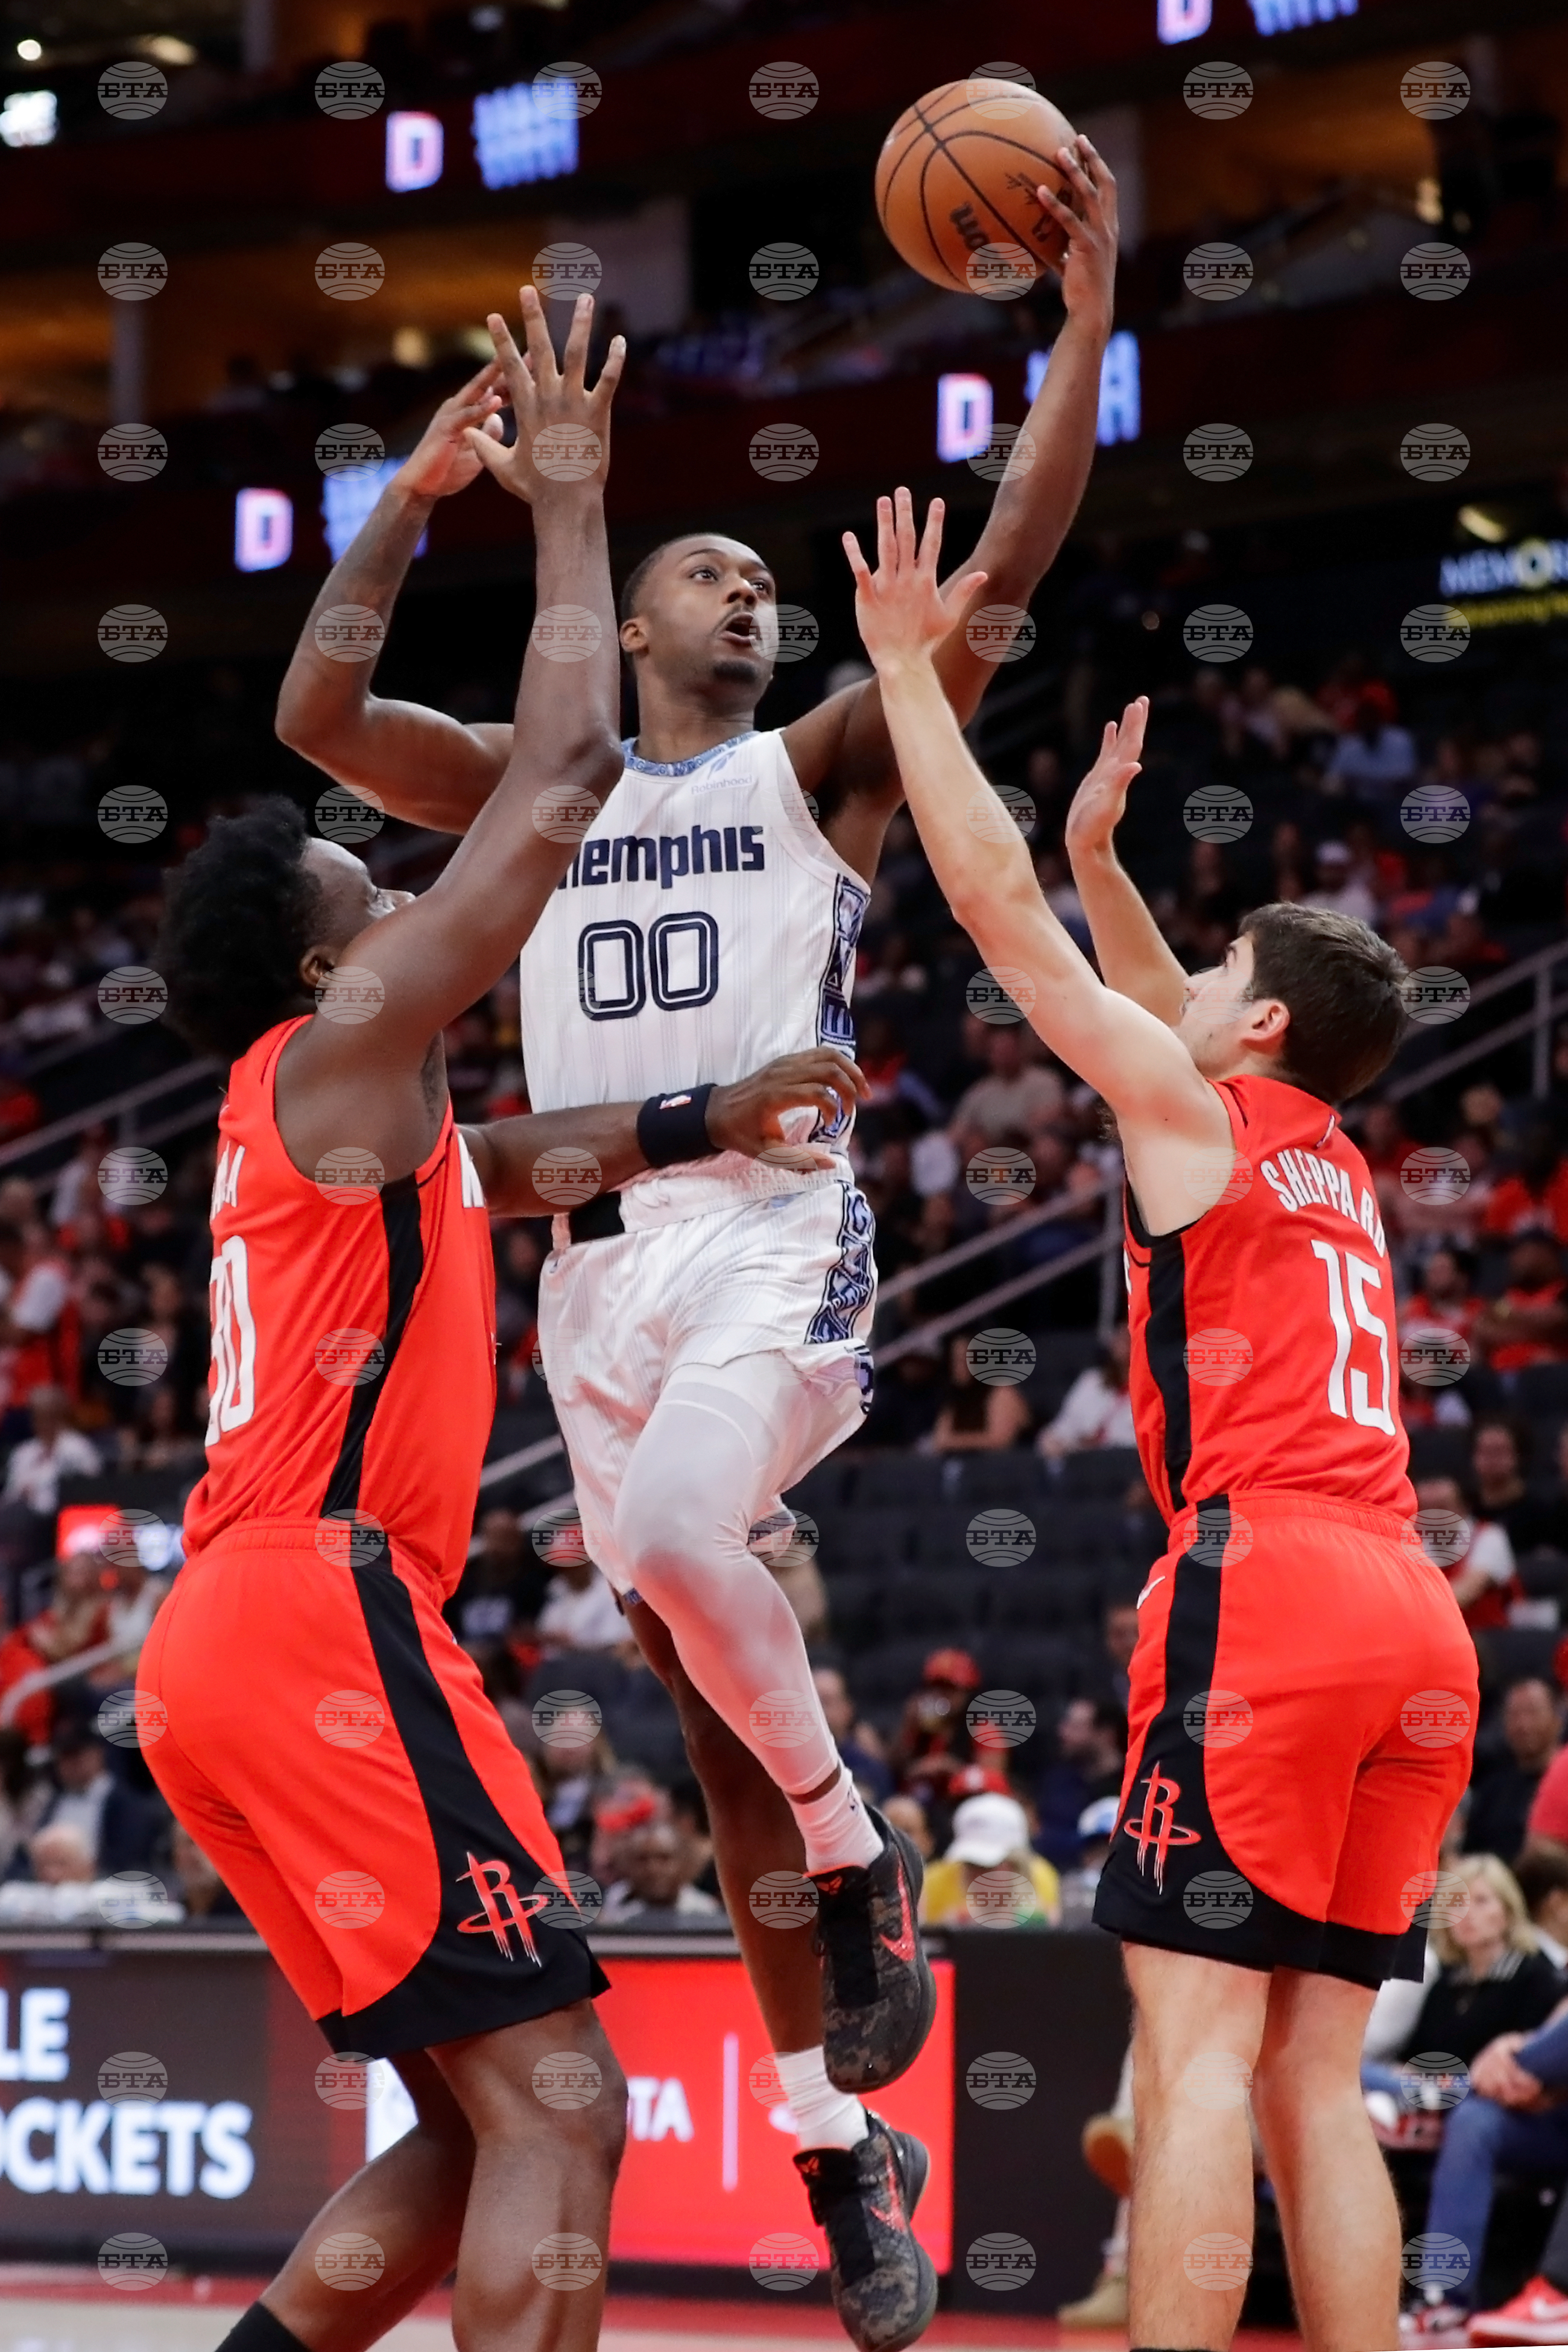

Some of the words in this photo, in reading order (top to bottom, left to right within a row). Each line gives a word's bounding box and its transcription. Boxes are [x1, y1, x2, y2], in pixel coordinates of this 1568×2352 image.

[386, 110, 444, 192] D
[937, 372, 993, 463] D
[235, 487, 293, 573] D
[691, 776, 753, 795] Robinhood
[577, 911, 719, 1020] 00
[1260, 1148, 1386, 1258] SHEPPARD
[1310, 1239, 1397, 1437] 15
[0, 2097, 254, 2199] CKETS
[626, 2075, 694, 2142] TA
